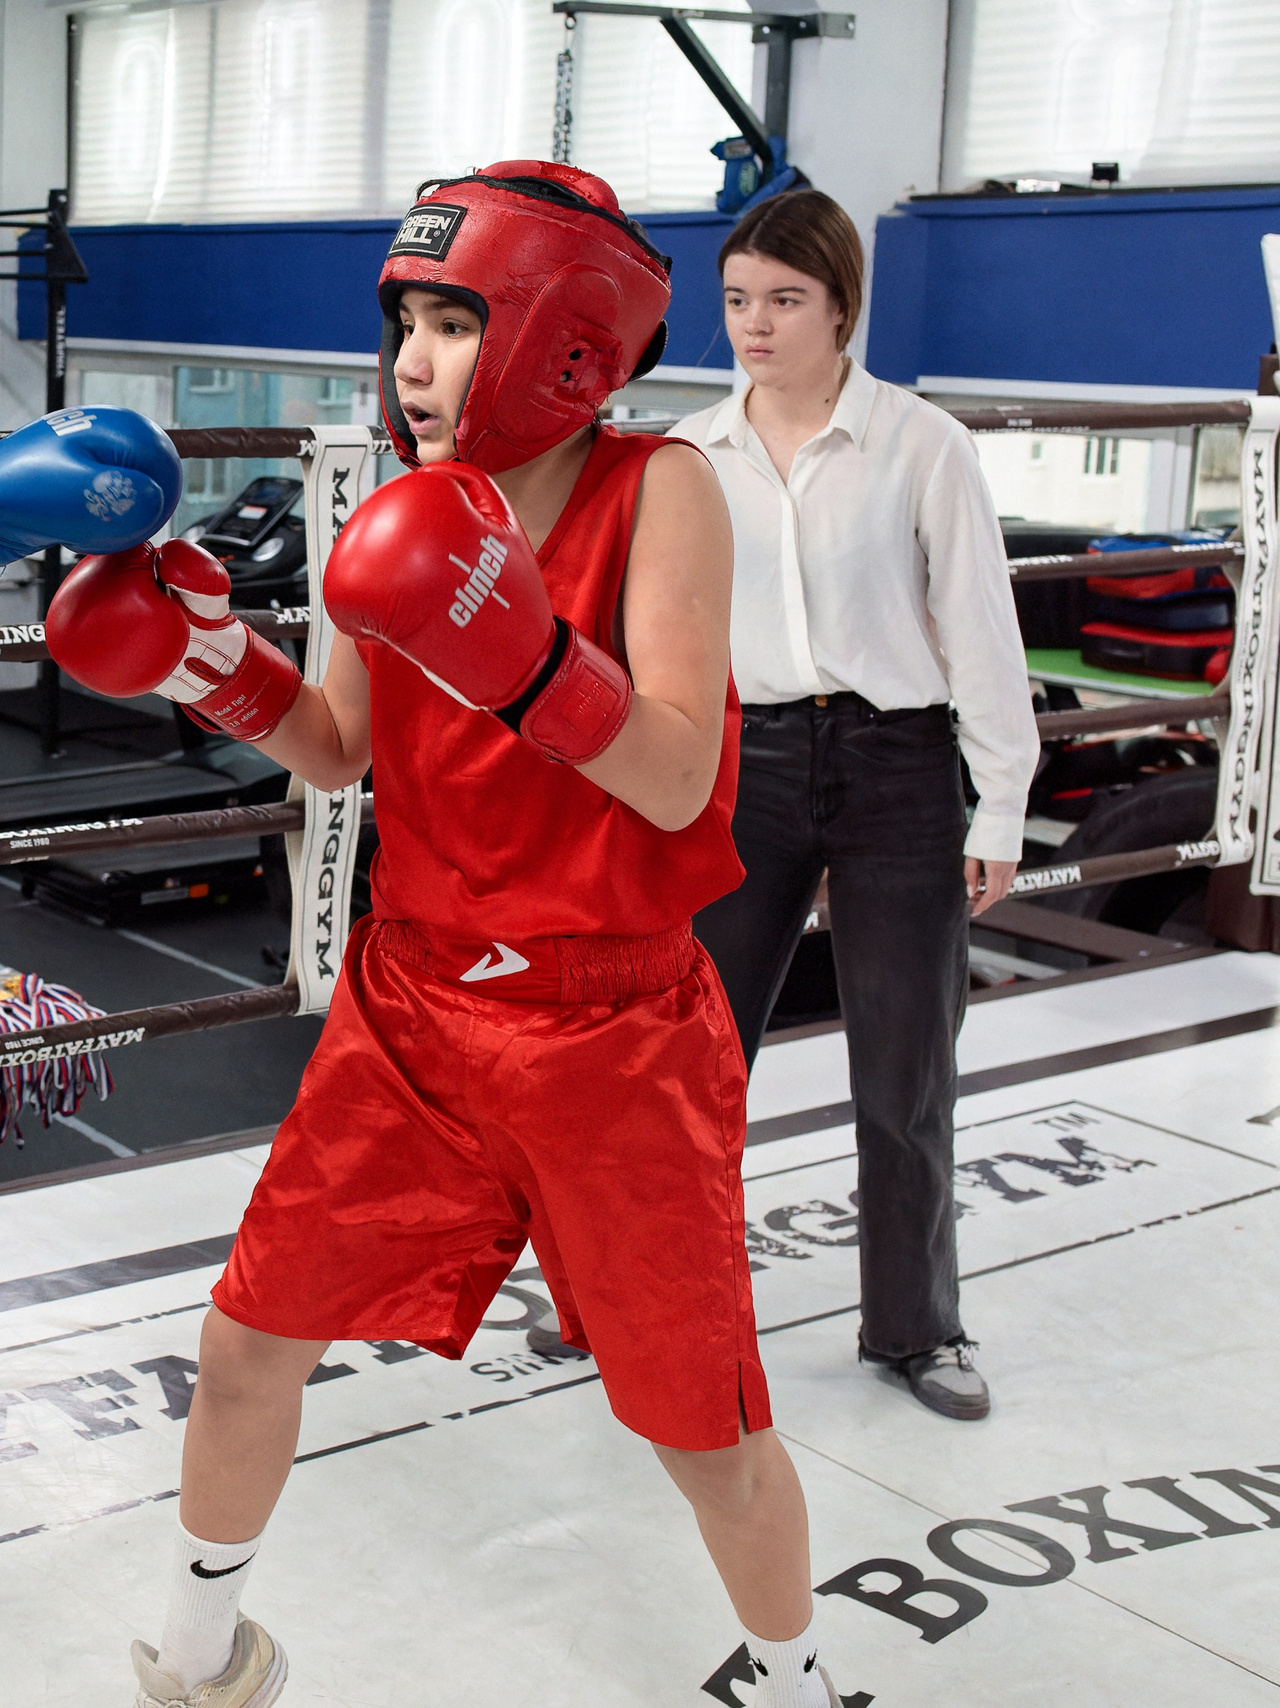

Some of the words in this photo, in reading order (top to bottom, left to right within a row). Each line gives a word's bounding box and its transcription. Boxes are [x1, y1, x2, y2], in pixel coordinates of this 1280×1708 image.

[403, 214, 451, 230] GREEN
[395, 227, 433, 245] HILL
[448, 533, 509, 629] clinch
[231, 694, 247, 707] Fight
[241, 708, 259, 722] edition
[10, 839, 33, 849] SINCE
[34, 837, 50, 847] 1980
